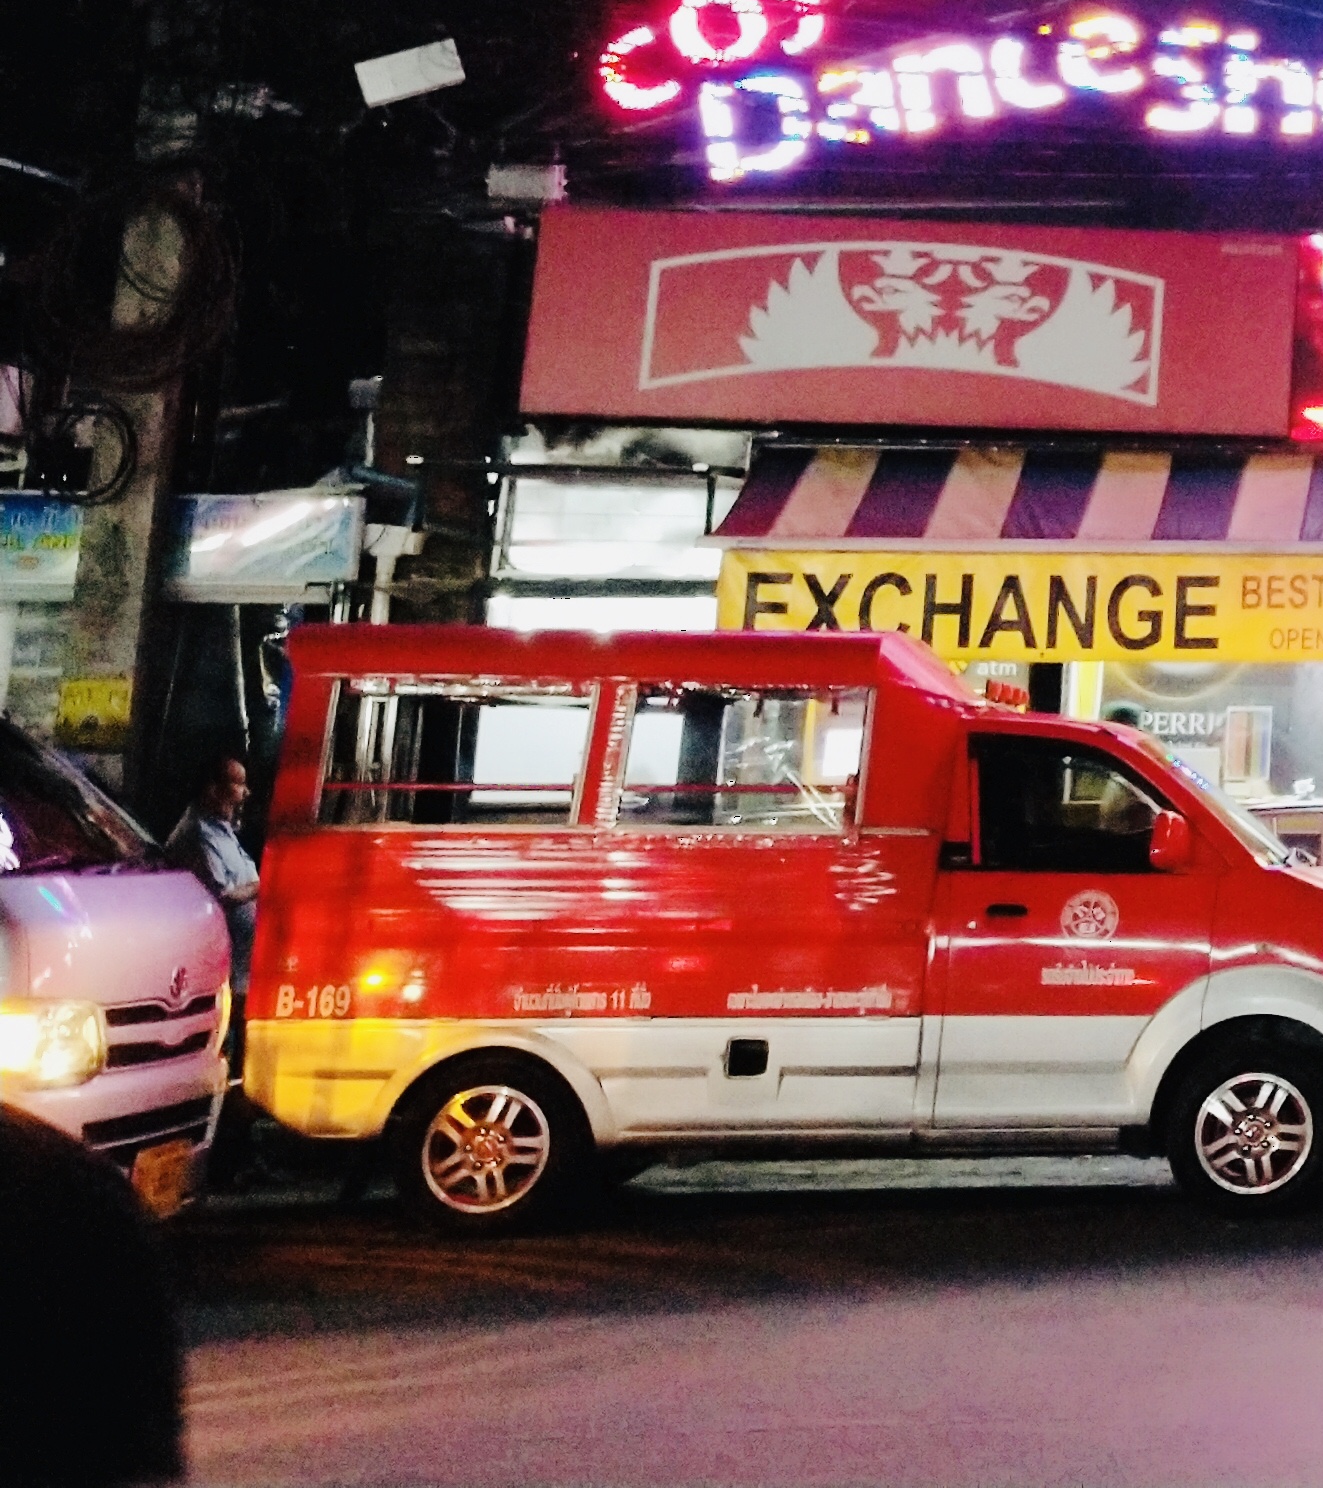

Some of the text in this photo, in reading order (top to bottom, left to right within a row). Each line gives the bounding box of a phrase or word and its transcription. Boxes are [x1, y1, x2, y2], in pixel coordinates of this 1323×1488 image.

[744, 572, 1221, 650] EXCHANGE
[977, 659, 1017, 676] atm
[275, 984, 351, 1017] B-169
